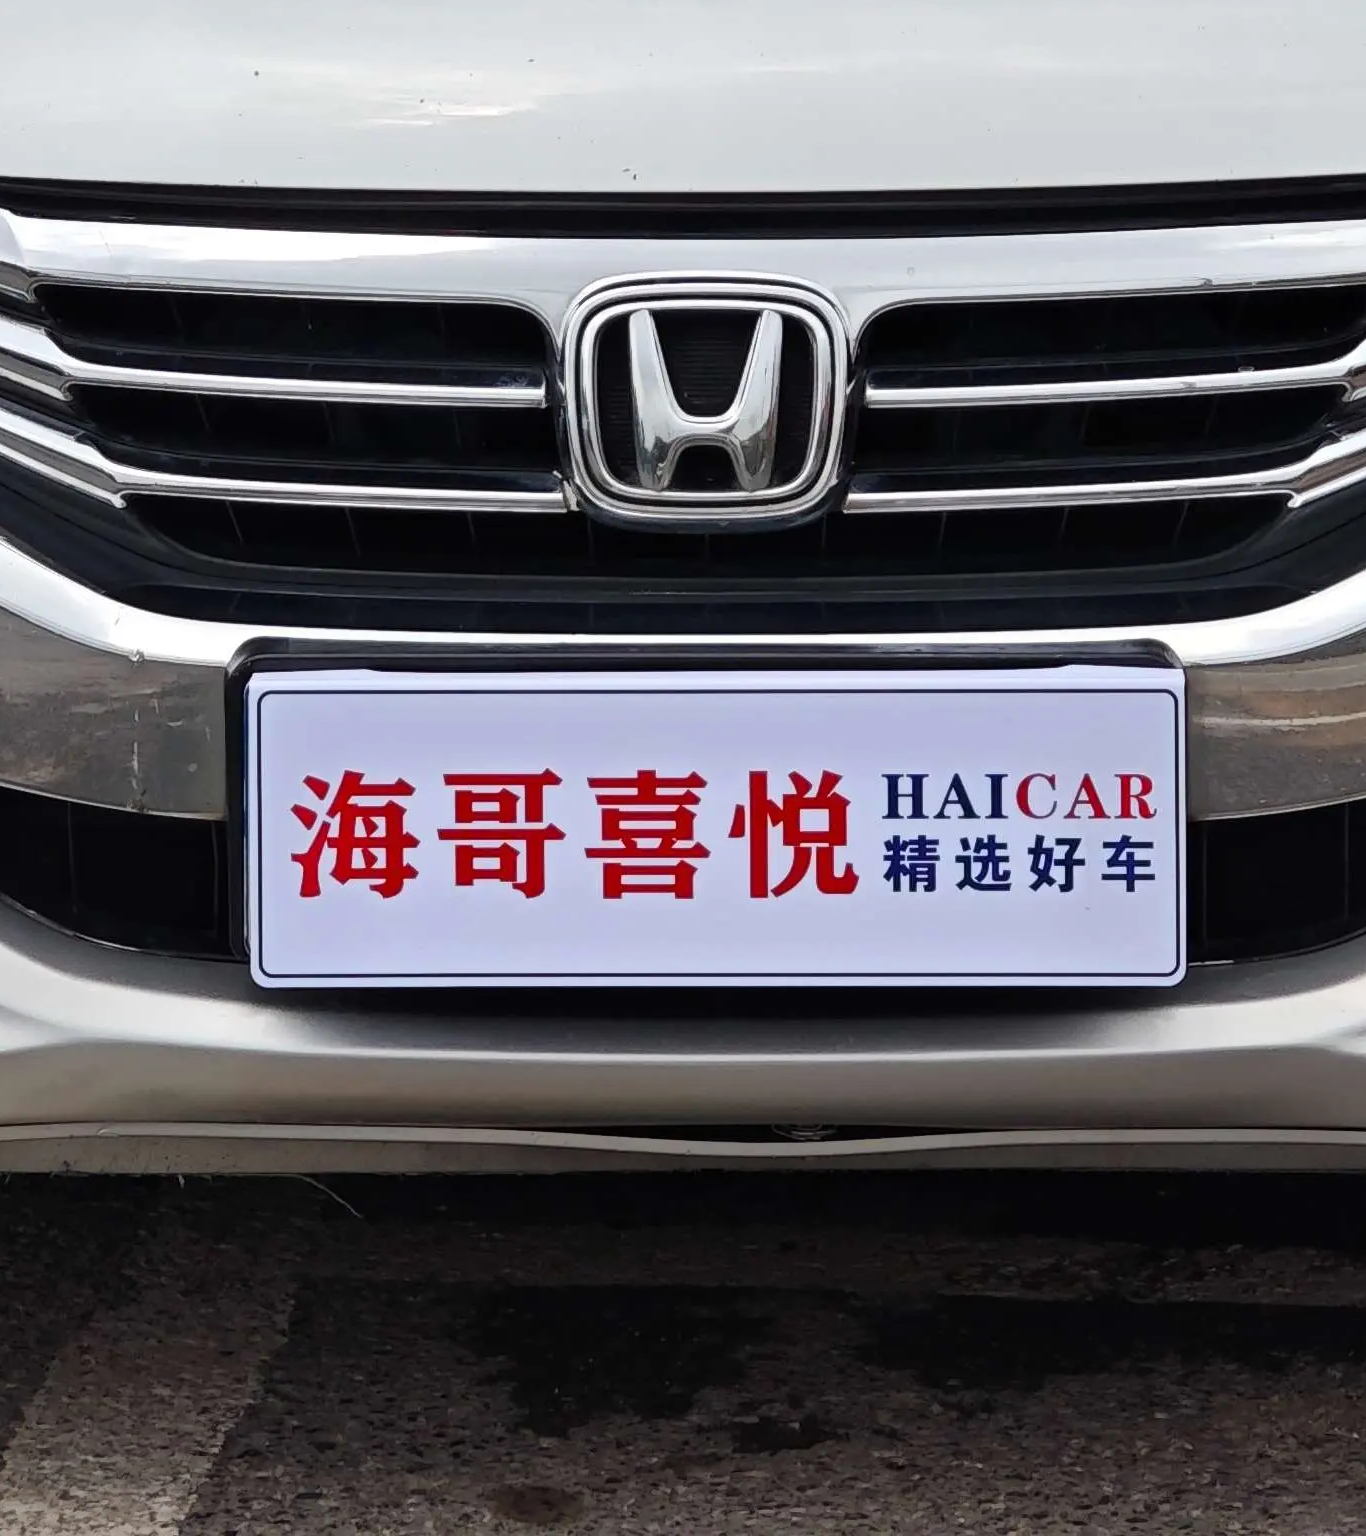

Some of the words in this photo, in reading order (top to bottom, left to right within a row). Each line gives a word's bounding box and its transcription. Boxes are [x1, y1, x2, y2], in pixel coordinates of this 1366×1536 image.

[882, 772, 1158, 822] HAICAR
[291, 767, 860, 900] 海哥喜悦
[882, 833, 1158, 893] 精选好车
